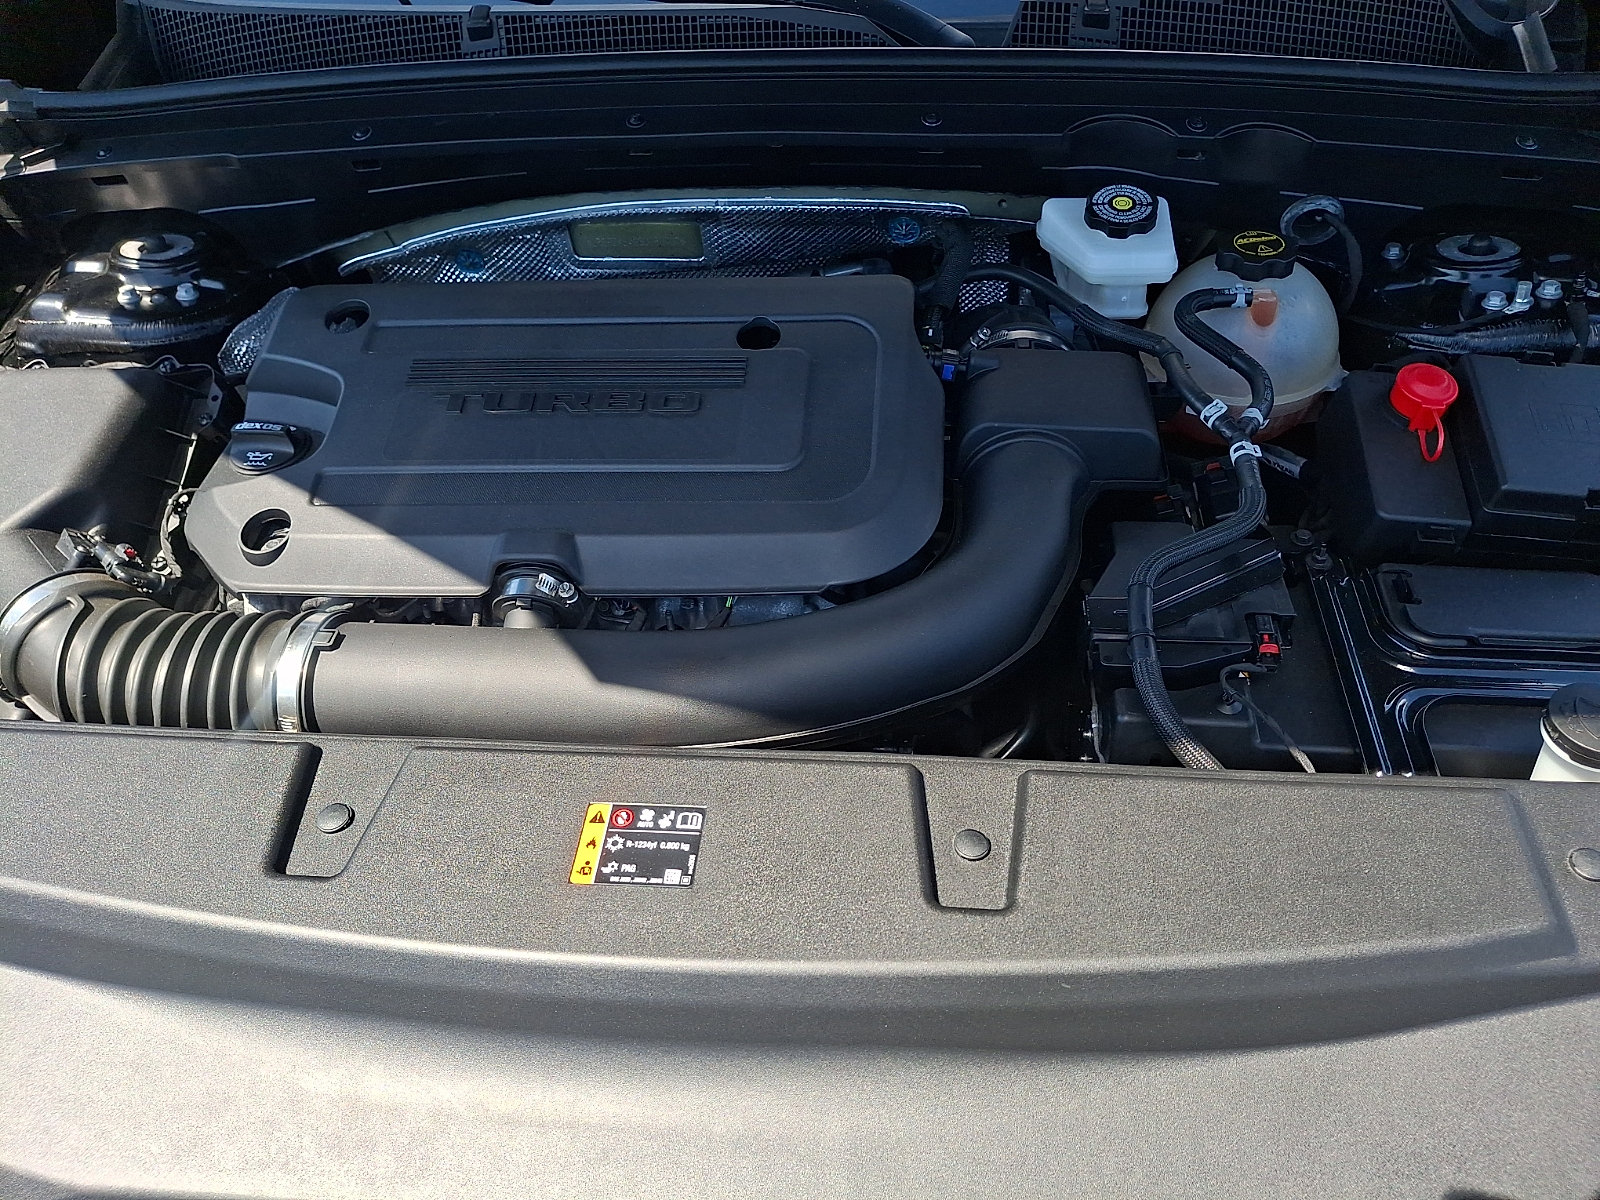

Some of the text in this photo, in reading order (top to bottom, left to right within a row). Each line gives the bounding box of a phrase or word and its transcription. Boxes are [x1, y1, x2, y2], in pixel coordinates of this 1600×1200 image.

[433, 391, 702, 414] TURBO
[235, 422, 282, 431] dexos
[620, 863, 637, 873] PAG
